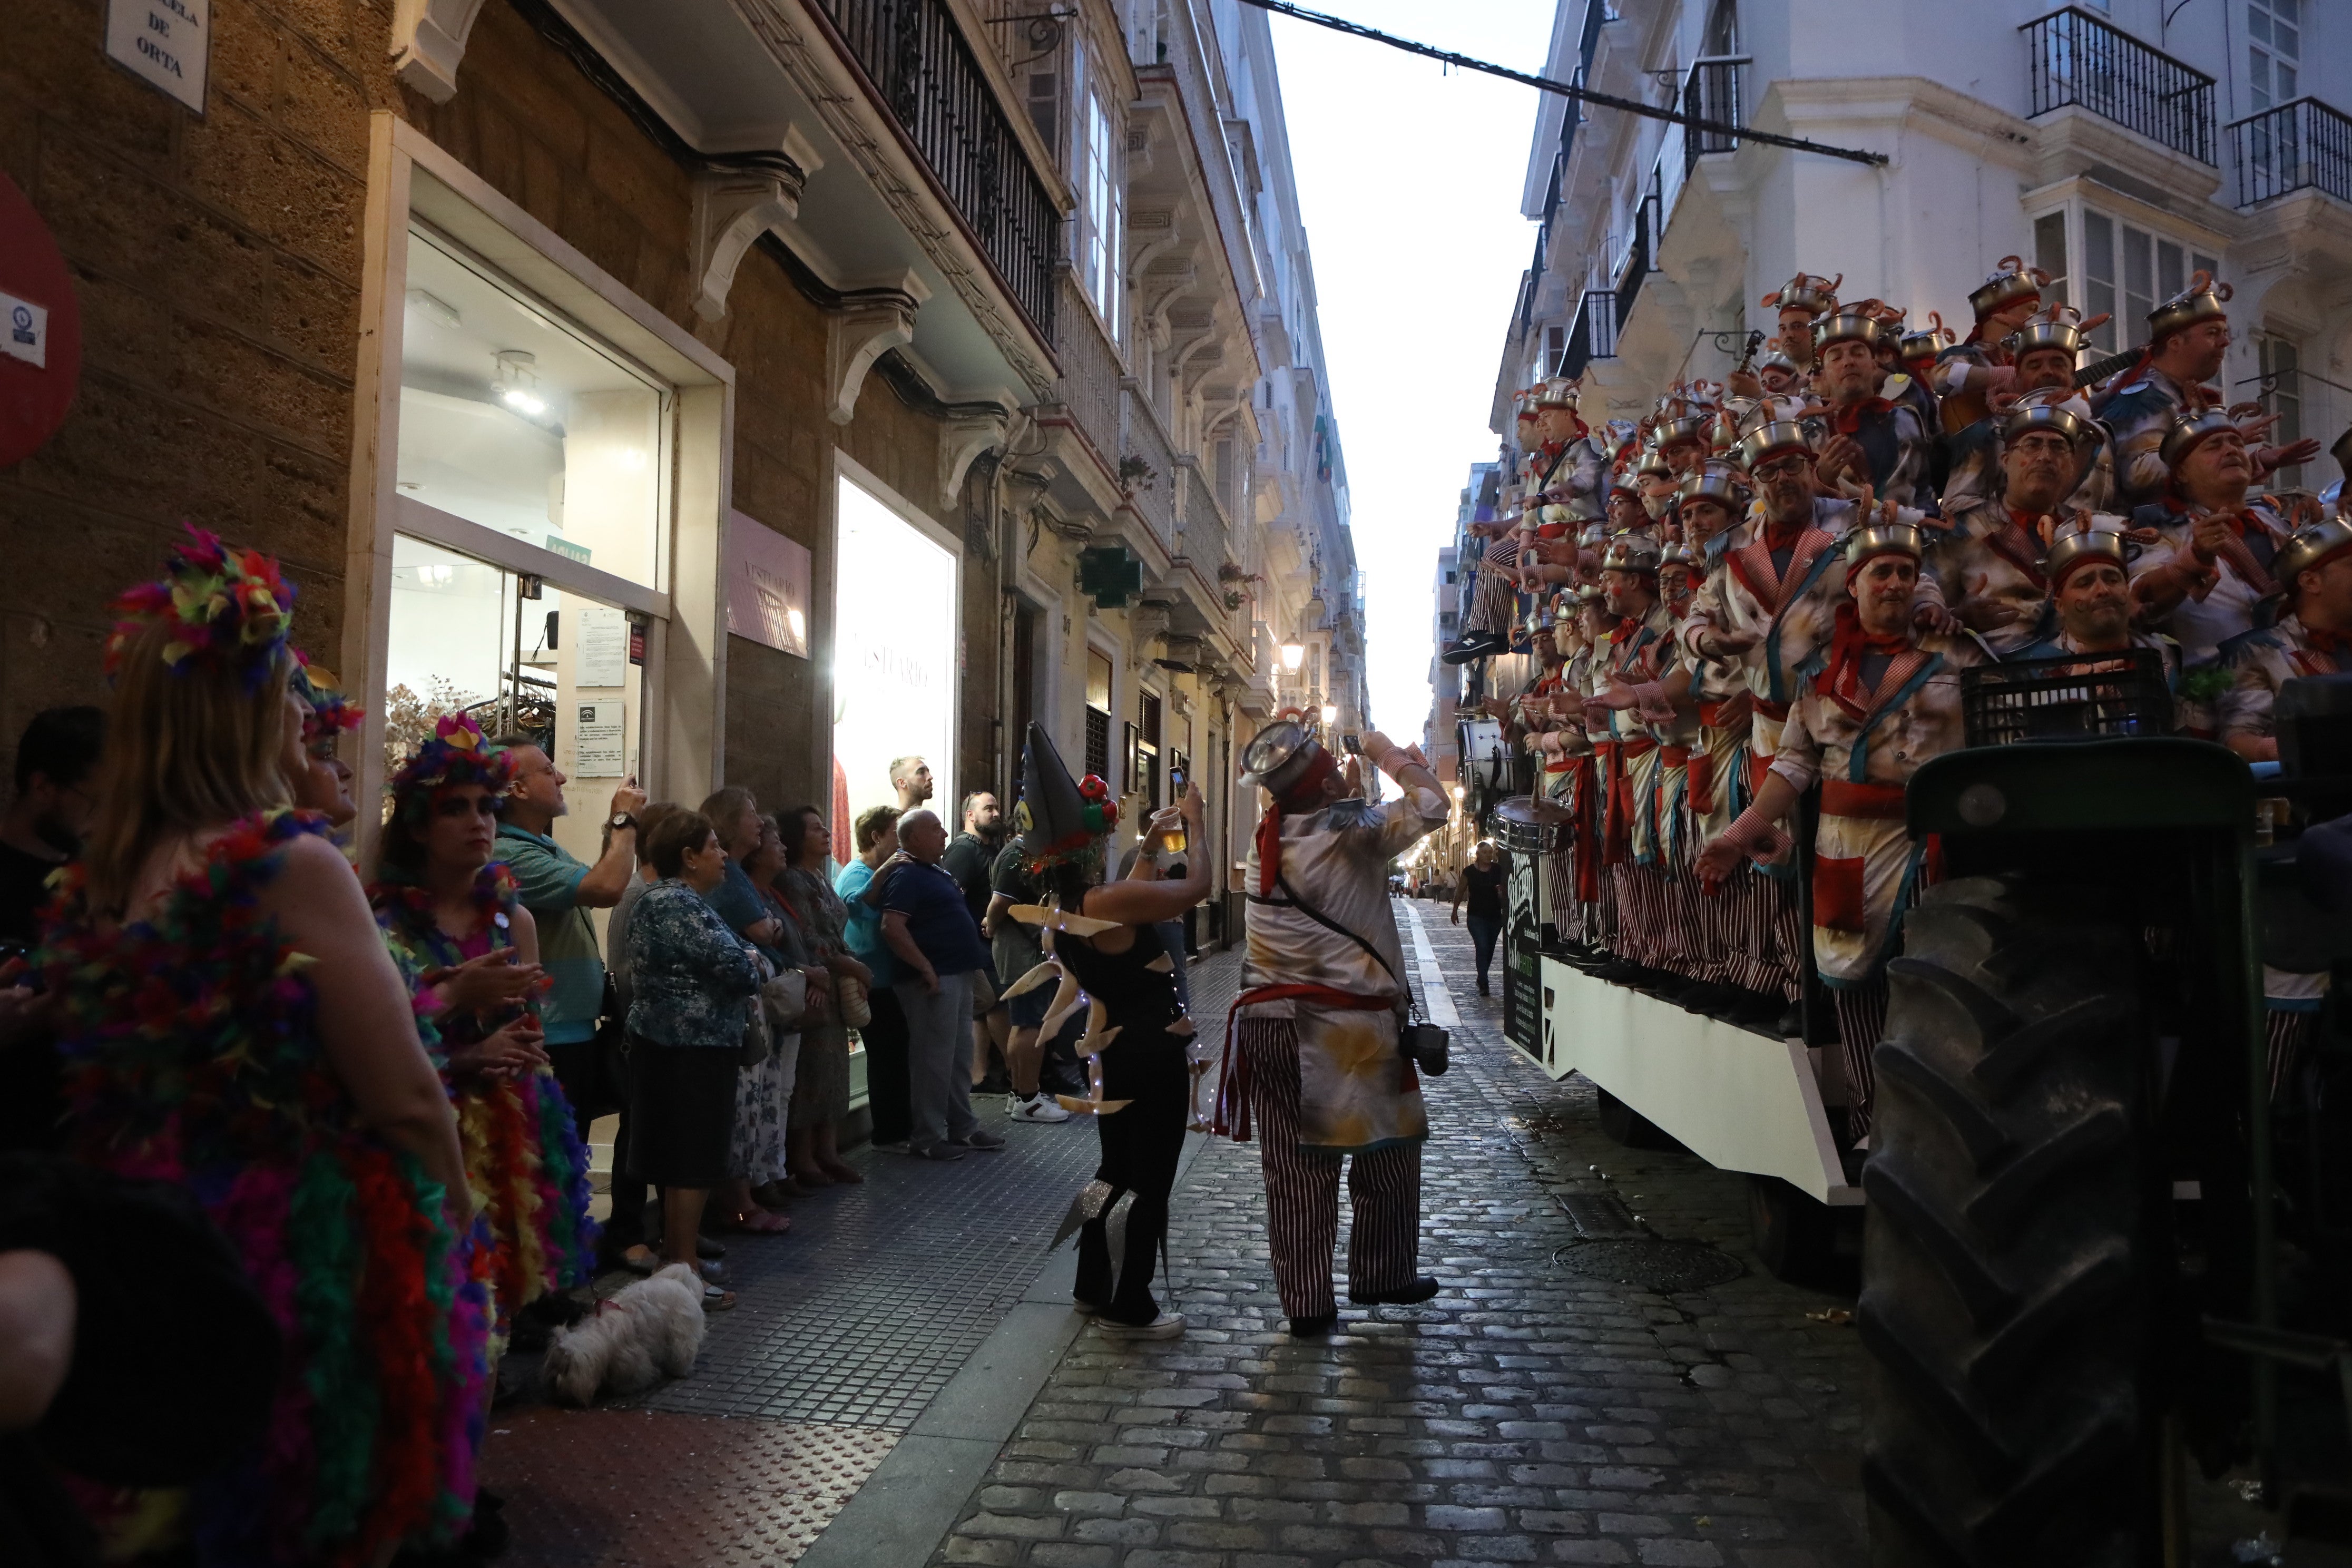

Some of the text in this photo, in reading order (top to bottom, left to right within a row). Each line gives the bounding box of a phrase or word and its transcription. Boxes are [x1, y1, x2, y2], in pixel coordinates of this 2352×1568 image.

[149, 11, 170, 38] DE
[136, 36, 183, 79] ORTA
[745, 561, 795, 596] VESTUARIO
